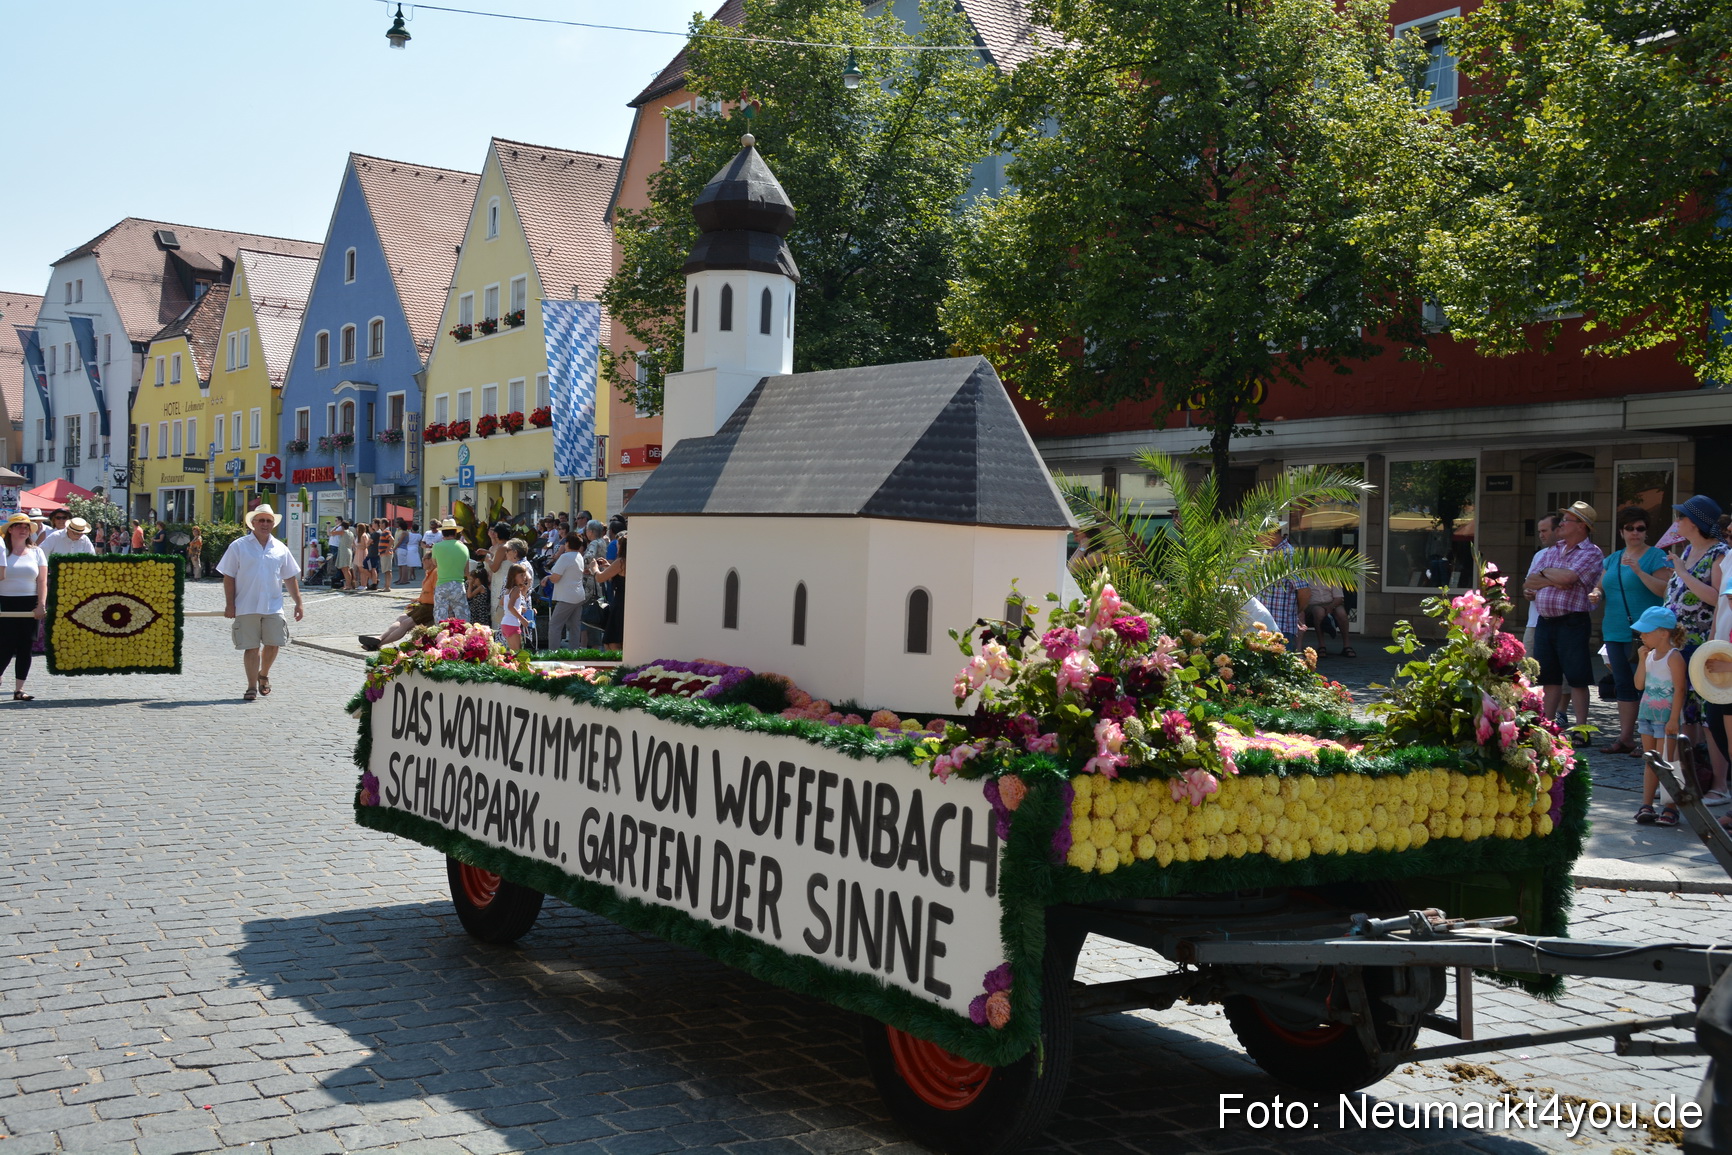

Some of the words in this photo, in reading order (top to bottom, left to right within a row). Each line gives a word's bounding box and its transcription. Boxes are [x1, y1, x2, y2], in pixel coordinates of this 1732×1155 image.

[1304, 374, 1398, 412] JOSEF
[163, 401, 181, 417] HOTEL
[160, 472, 185, 484] Restaurant
[292, 466, 336, 484] APOTHEKE
[462, 468, 472, 485] P
[391, 682, 433, 746] DAS
[439, 692, 622, 795] WOHNZIMMER
[632, 729, 699, 819] VON
[712, 749, 998, 898] WOFFENBACH
[385, 751, 540, 852] SCHLOßPARK
[543, 818, 567, 864] u.
[578, 806, 701, 909] GARTEN
[710, 839, 783, 940] DER
[803, 872, 954, 999] SINNE
